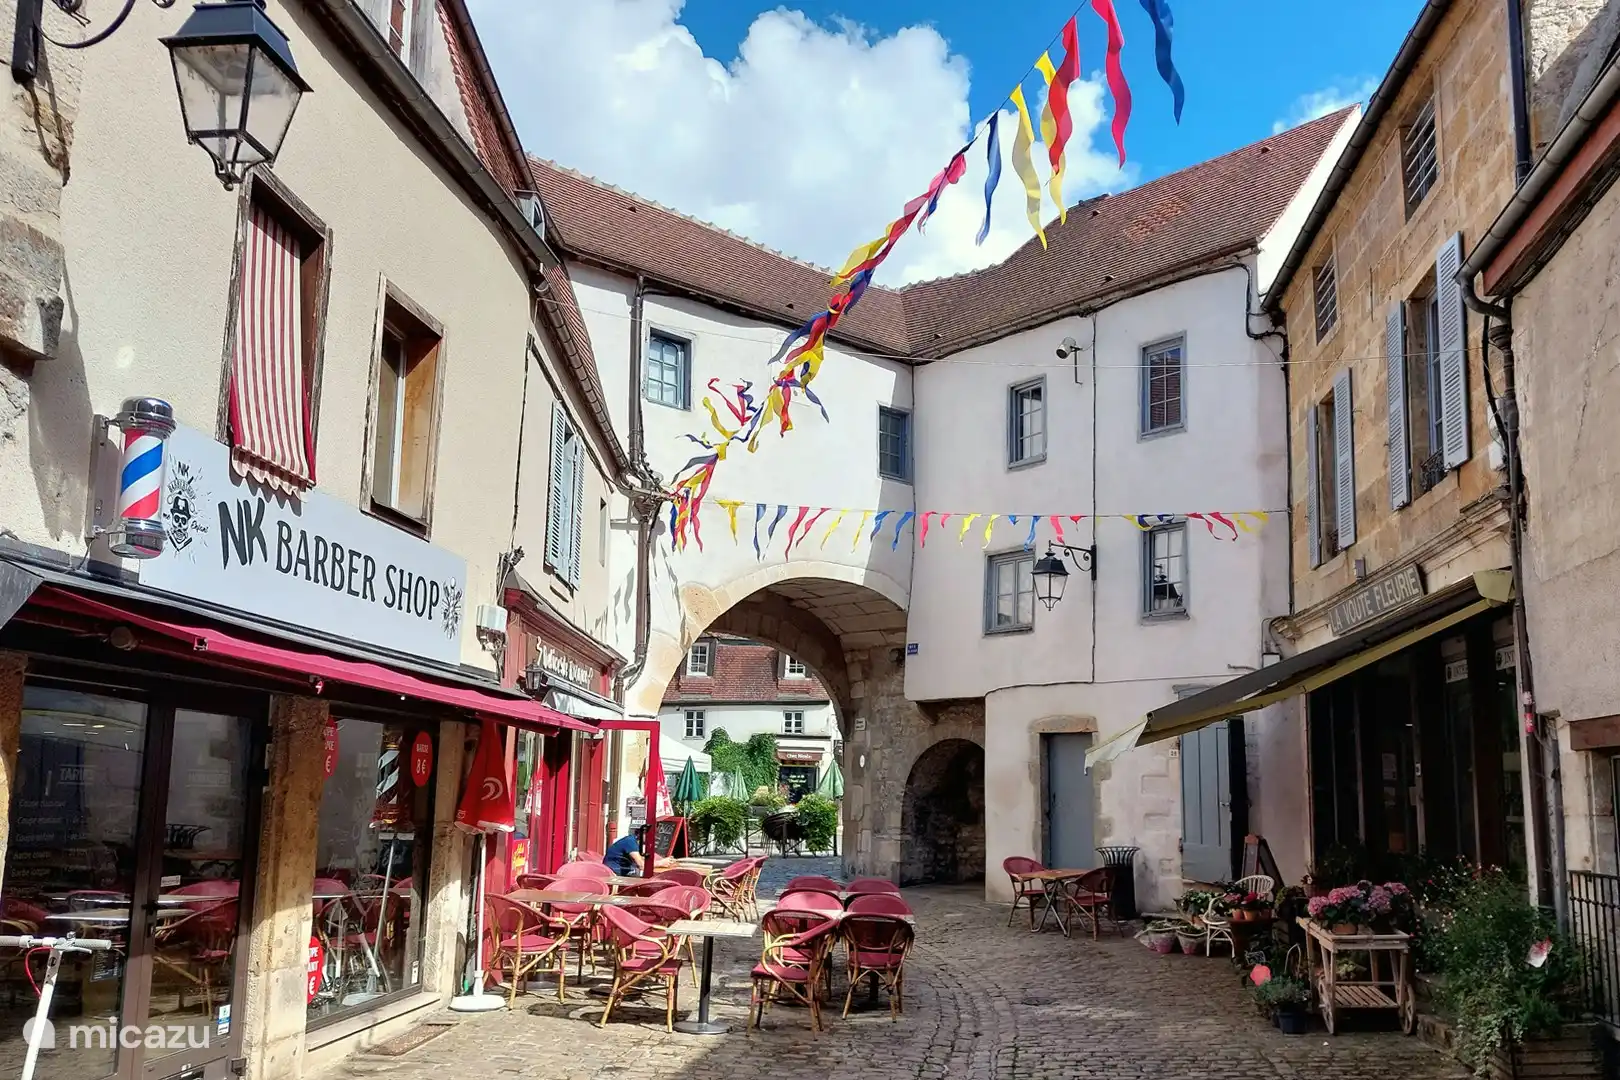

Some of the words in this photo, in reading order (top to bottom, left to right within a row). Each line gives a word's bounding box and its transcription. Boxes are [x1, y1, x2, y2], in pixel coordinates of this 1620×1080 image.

[178, 461, 190, 477] NK
[218, 497, 268, 570] NK
[276, 520, 376, 602] BARBER
[384, 564, 439, 620] SHOP
[1330, 609, 1343, 632] LA
[1342, 591, 1373, 625] VOUTE
[1373, 566, 1419, 610] FLEURIE
